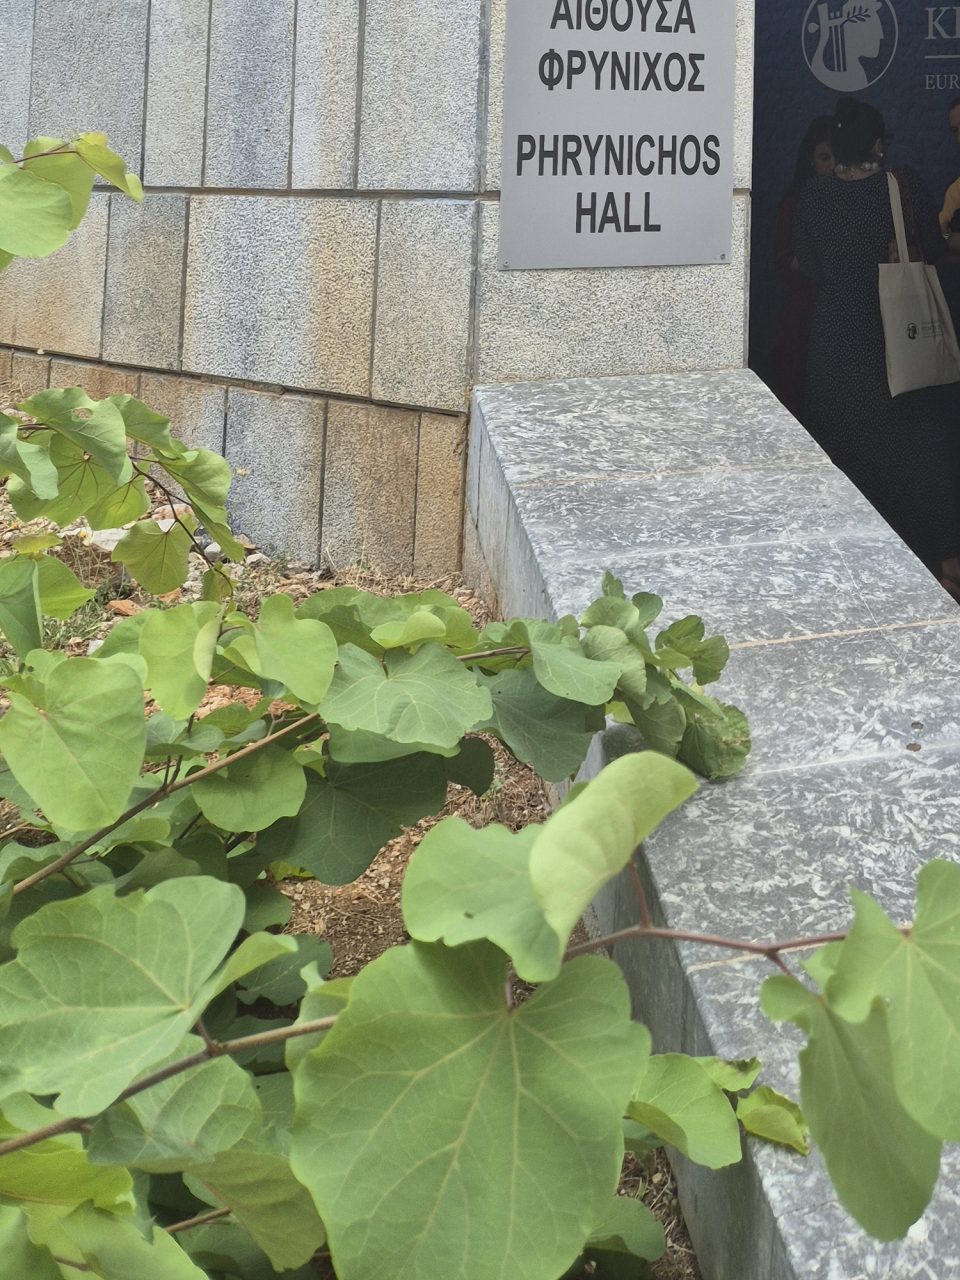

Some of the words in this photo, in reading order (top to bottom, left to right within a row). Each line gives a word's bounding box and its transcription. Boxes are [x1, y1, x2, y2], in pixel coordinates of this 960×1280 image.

[538, 48, 705, 92] ΦΡΥΝΙΧΟΣ
[516, 133, 721, 176] PHRYNICHOS
[575, 191, 662, 234] HALL
